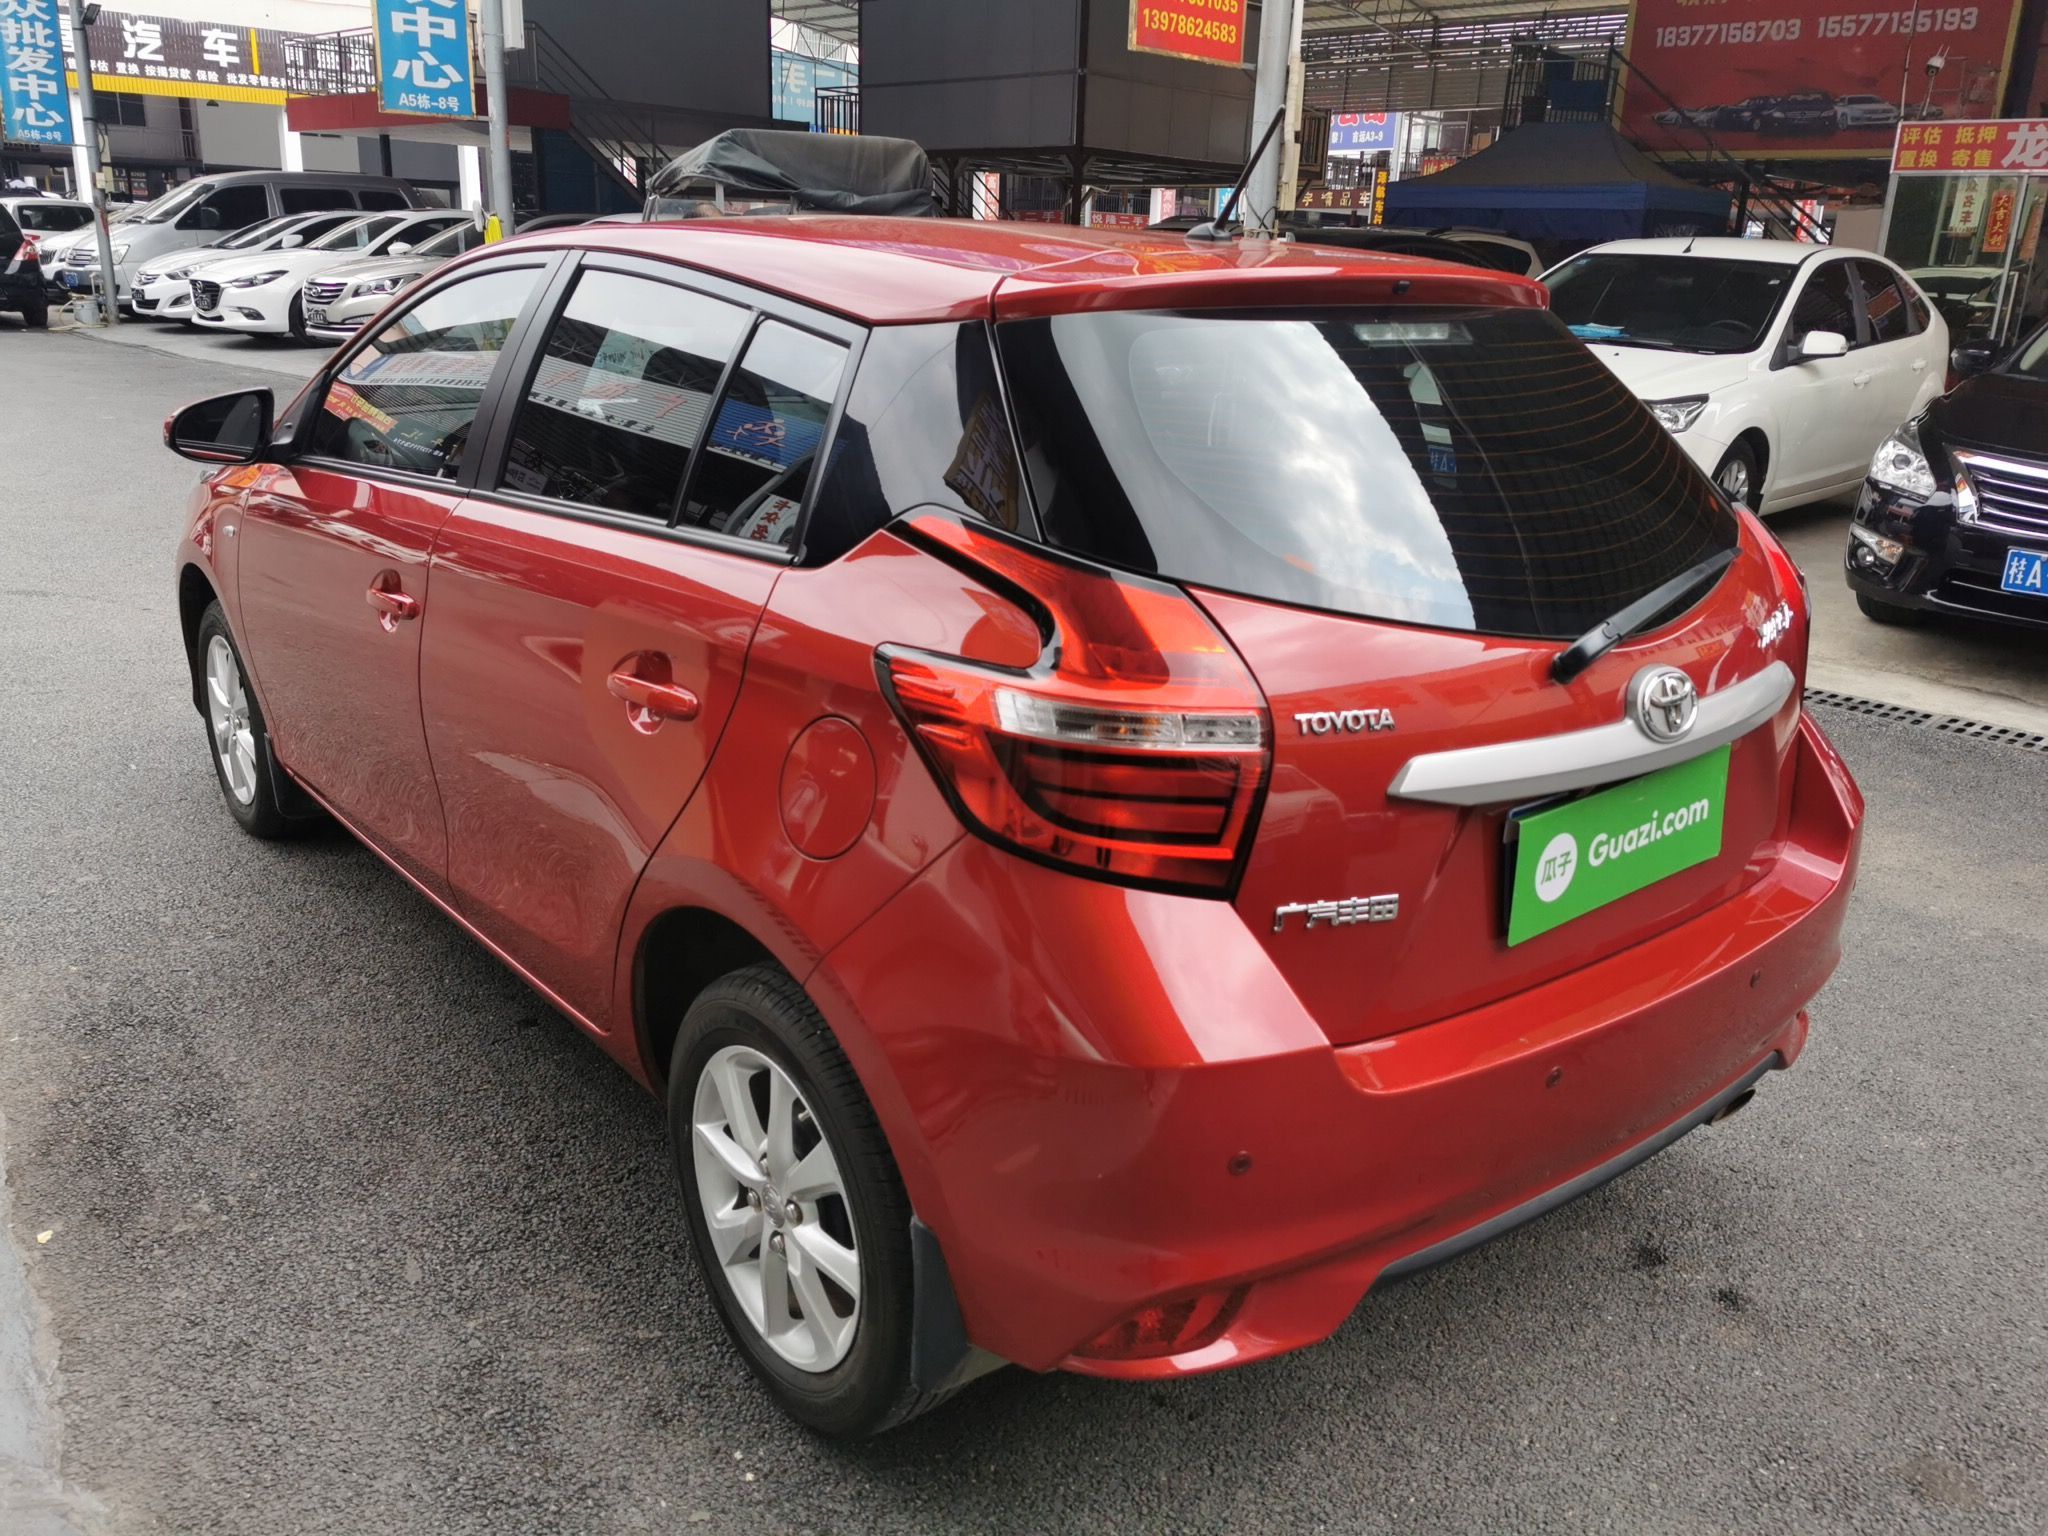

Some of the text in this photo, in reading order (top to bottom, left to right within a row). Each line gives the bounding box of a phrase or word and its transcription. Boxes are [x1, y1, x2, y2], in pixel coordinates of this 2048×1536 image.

[1143, 8, 1237, 44] 13978624583
[1817, 7, 1979, 39] 15577135193
[391, 0, 464, 88] 中心
[399, 92, 460, 112] A5栋-8号
[1902, 127, 1943, 145] 评估
[1955, 126, 1998, 145] 抵押
[1898, 149, 1993, 168] 置换 寄售
[1294, 709, 1396, 736] TOYOTA
[1541, 798, 1710, 885] 瓜子 Guazi.com
